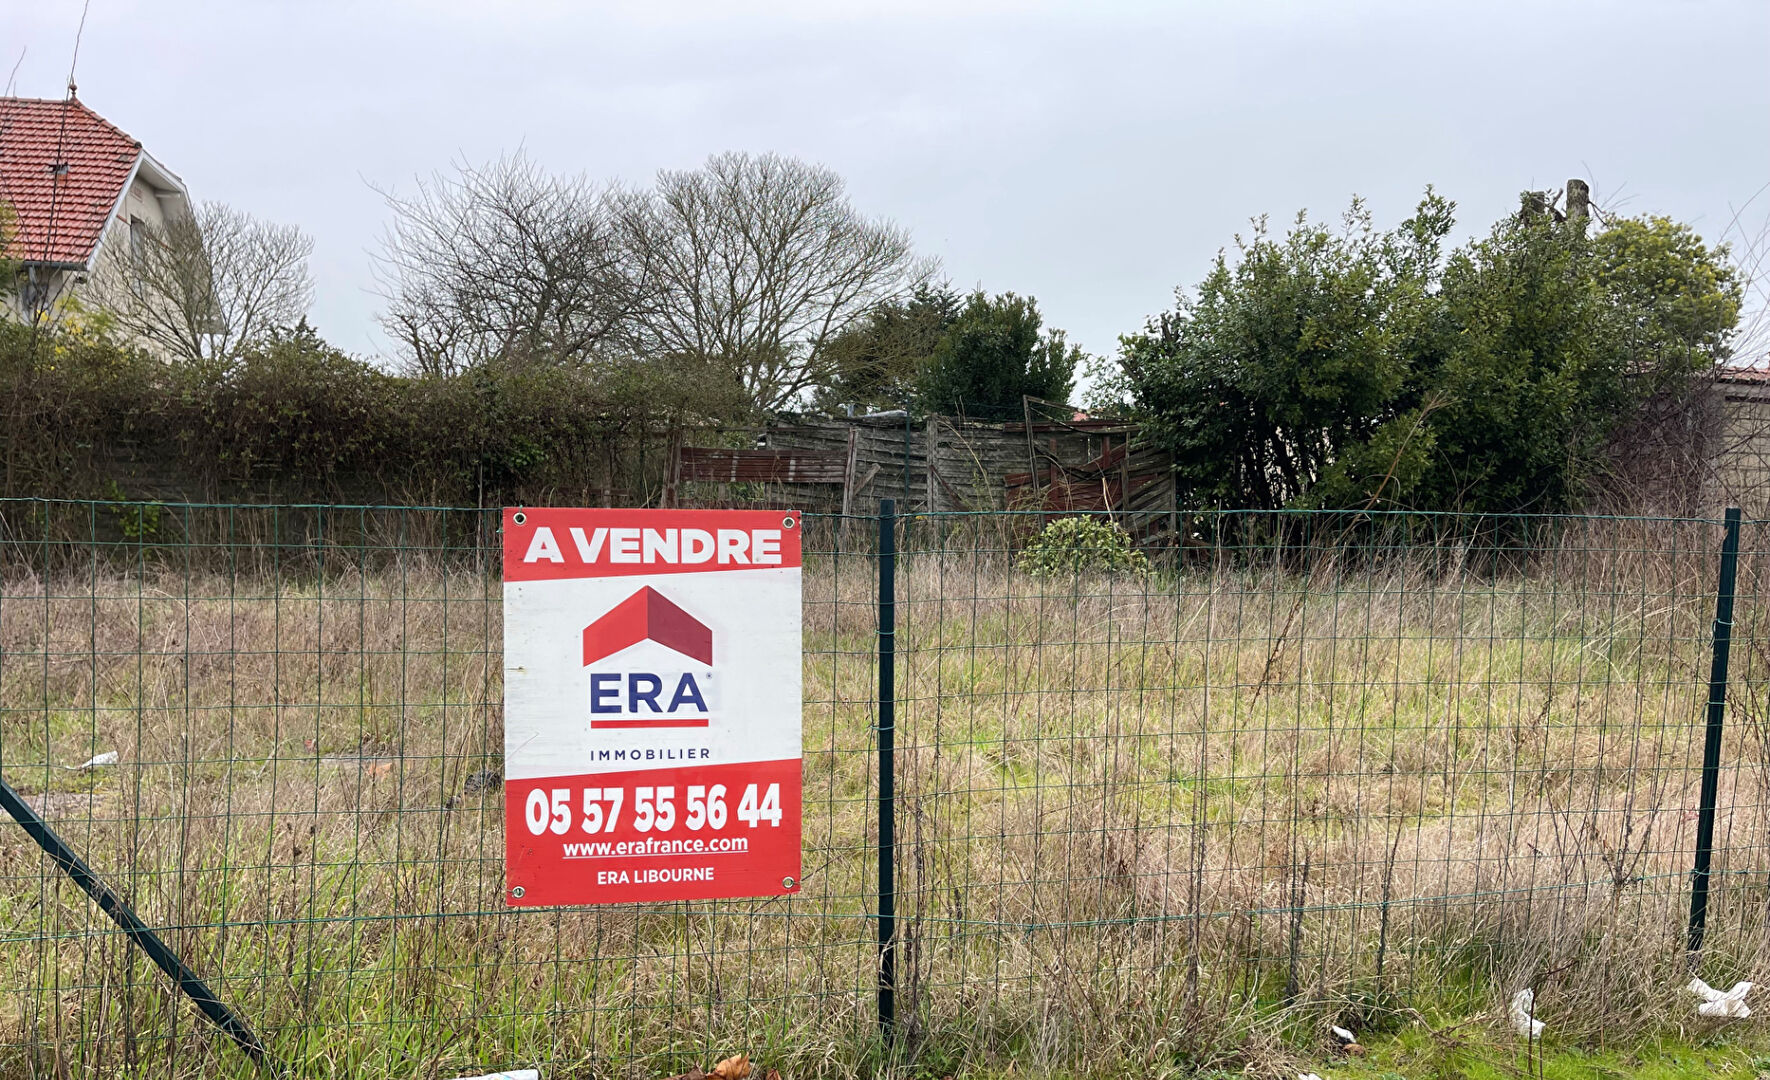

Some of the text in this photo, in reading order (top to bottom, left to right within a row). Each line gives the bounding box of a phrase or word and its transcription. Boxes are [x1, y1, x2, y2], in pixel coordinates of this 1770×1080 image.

[524, 527, 782, 565] A VENDRE
[591, 672, 708, 713] ERA
[591, 748, 710, 761] IMMOBILIER
[525, 783, 782, 836] 05 57 55 56 44
[563, 837, 748, 856] www.erafrance.com
[597, 867, 714, 885] ERA LIBOURNE
